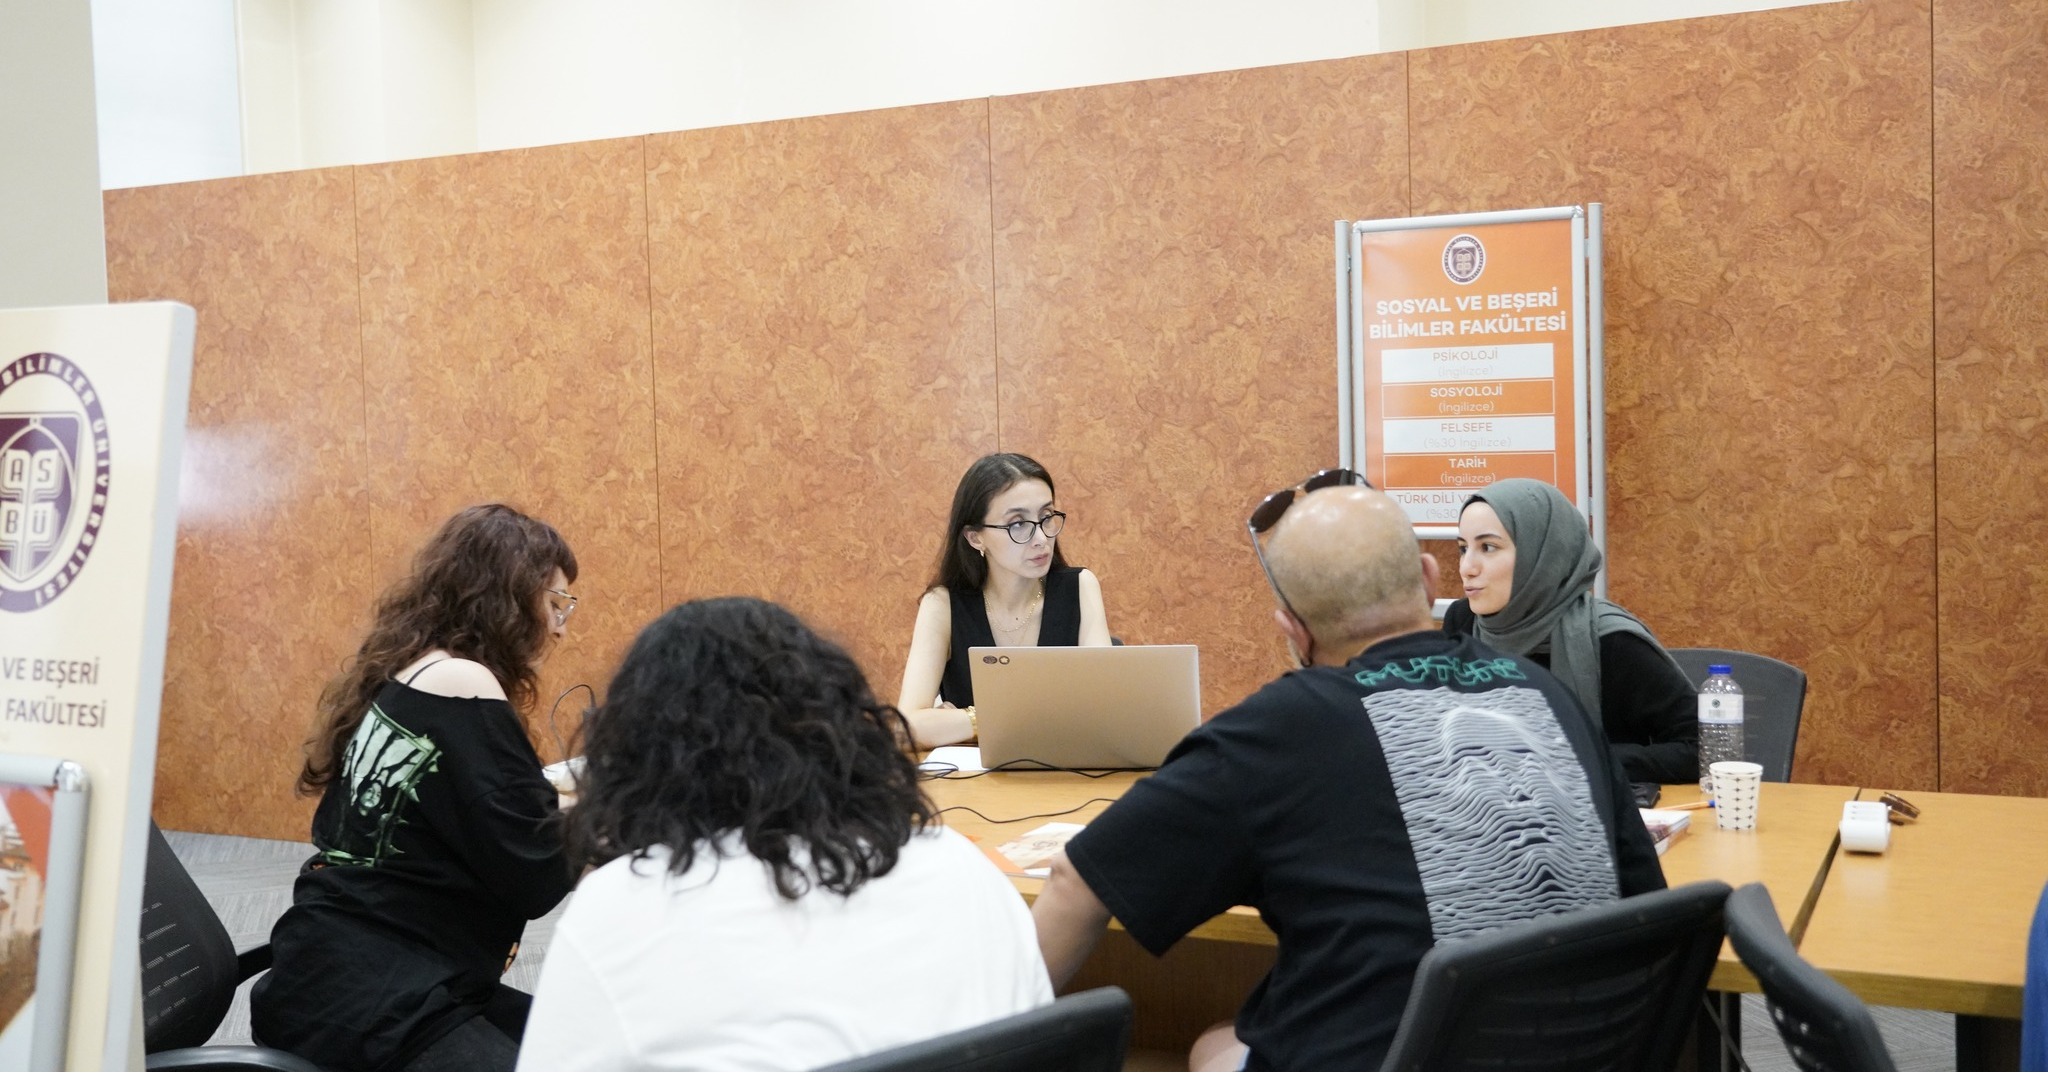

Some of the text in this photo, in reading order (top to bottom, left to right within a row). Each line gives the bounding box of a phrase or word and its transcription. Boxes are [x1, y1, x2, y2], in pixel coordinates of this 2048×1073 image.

[1376, 286, 1558, 315] SOSYAL VE BEŞERİ
[1369, 310, 1567, 339] BİLİMLER FAKÜLTESİ
[1433, 347, 1498, 362] PSİKOLOJİ
[1430, 383, 1503, 398] SOSYOLOJİ
[1438, 399, 1495, 415] (İngilizce)
[1441, 422, 1493, 433] FELSEFE
[1448, 455, 1487, 468] TARİH
[1440, 471, 1496, 486] (İngilizce)
[1397, 492, 1429, 504] TÜRK
[1432, 491, 1455, 504] DİLİ
[2, 657, 101, 689] VE BEŞERİ
[5, 695, 108, 729] FAKÜLTESİ
